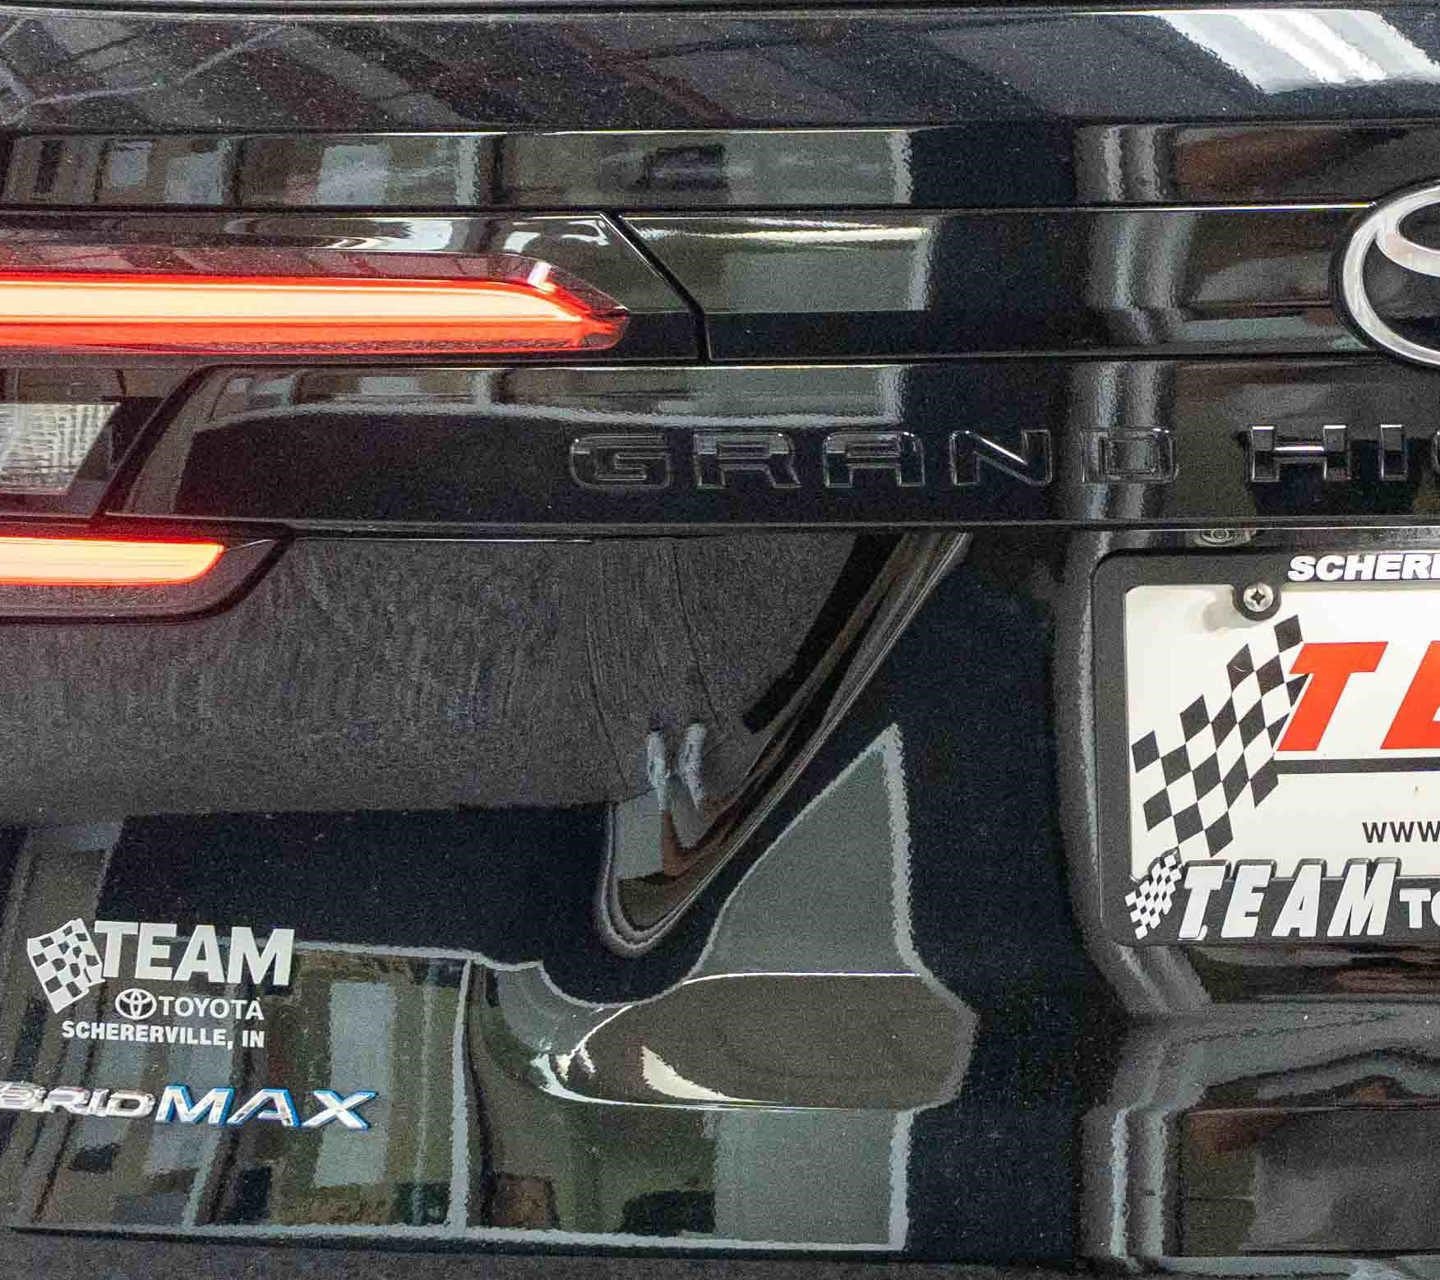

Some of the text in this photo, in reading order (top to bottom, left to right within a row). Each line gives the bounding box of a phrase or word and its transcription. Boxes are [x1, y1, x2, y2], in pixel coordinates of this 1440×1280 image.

[570, 426, 1179, 488] GRAND
[94, 920, 295, 986] TEAM
[158, 995, 264, 1020] TOYOTA
[61, 1019, 265, 1050] SCHERERVILLE, IN
